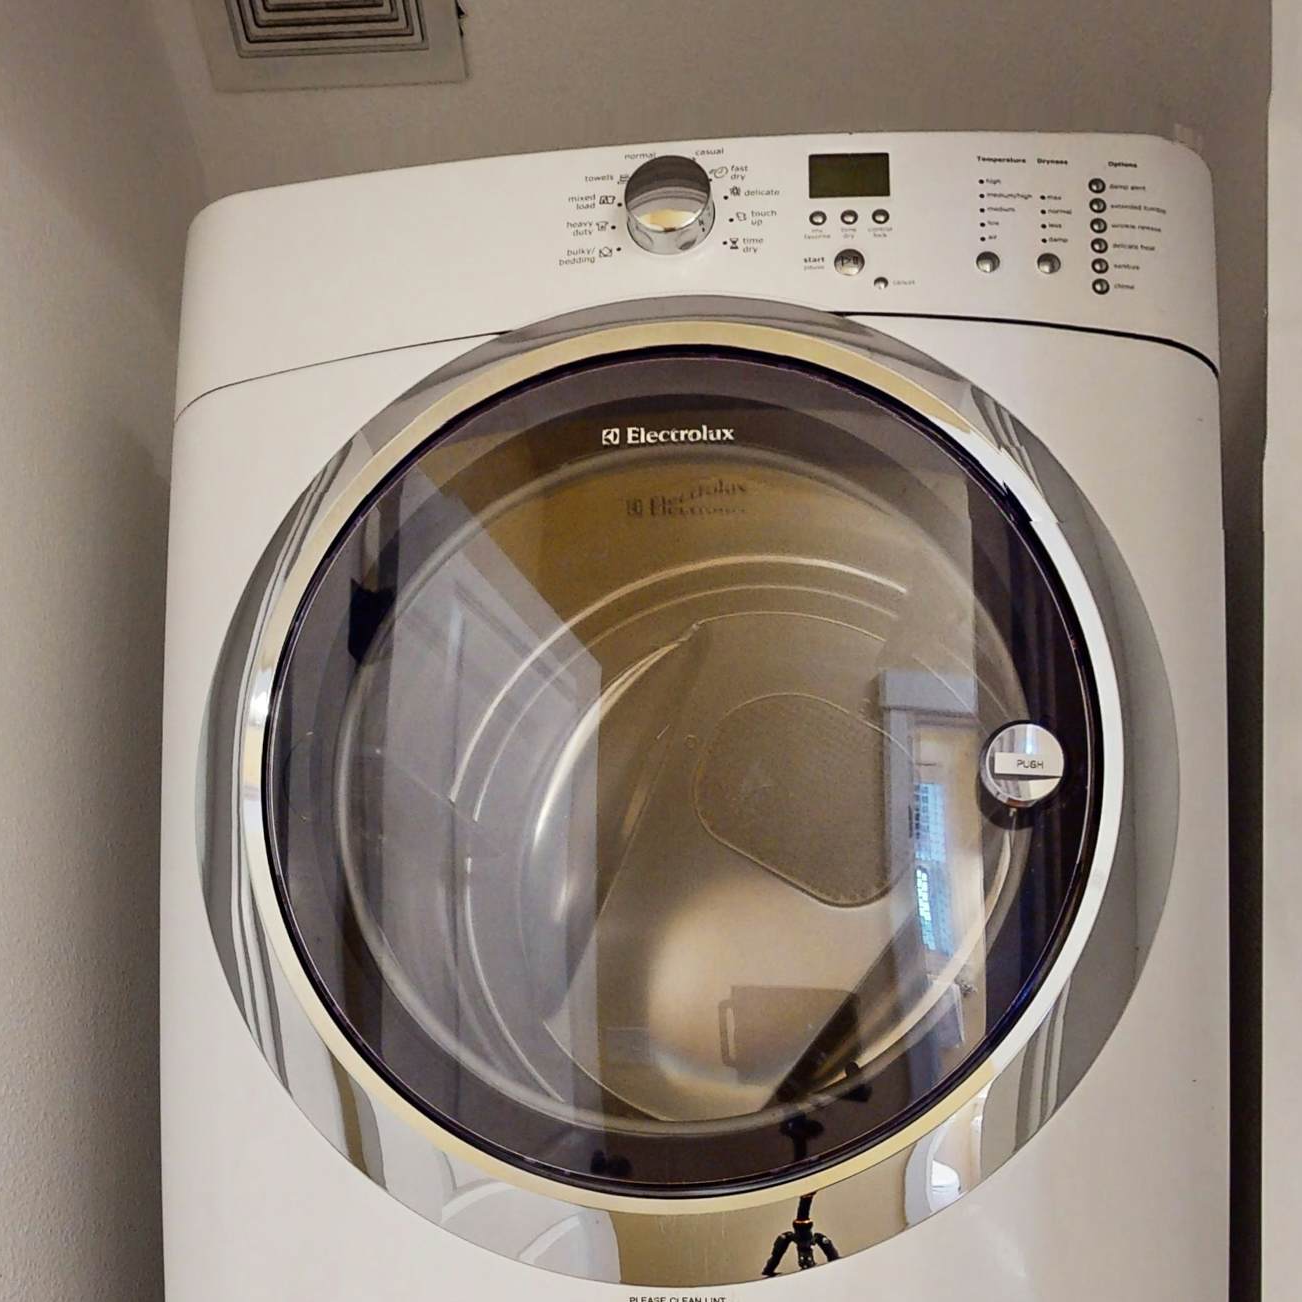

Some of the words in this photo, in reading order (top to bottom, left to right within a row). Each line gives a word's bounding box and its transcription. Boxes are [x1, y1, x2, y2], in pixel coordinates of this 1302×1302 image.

[695, 148, 724, 157] casual
[977, 155, 1026, 164] Temperature
[1036, 157, 1068, 165] Dryness
[731, 165, 748, 173] fast
[585, 174, 614, 182] towels
[731, 173, 746, 181] dry
[744, 188, 781, 197] delicate
[568, 194, 596, 202] mixed
[751, 210, 777, 218] touch
[566, 221, 594, 230] heavy
[572, 230, 593, 238] duty
[743, 237, 764, 245] time
[559, 256, 596, 266] bedding
[803, 256, 825, 264] start
[626, 424, 735, 444] Electrolux
[1016, 758, 1045, 770] PUSH
